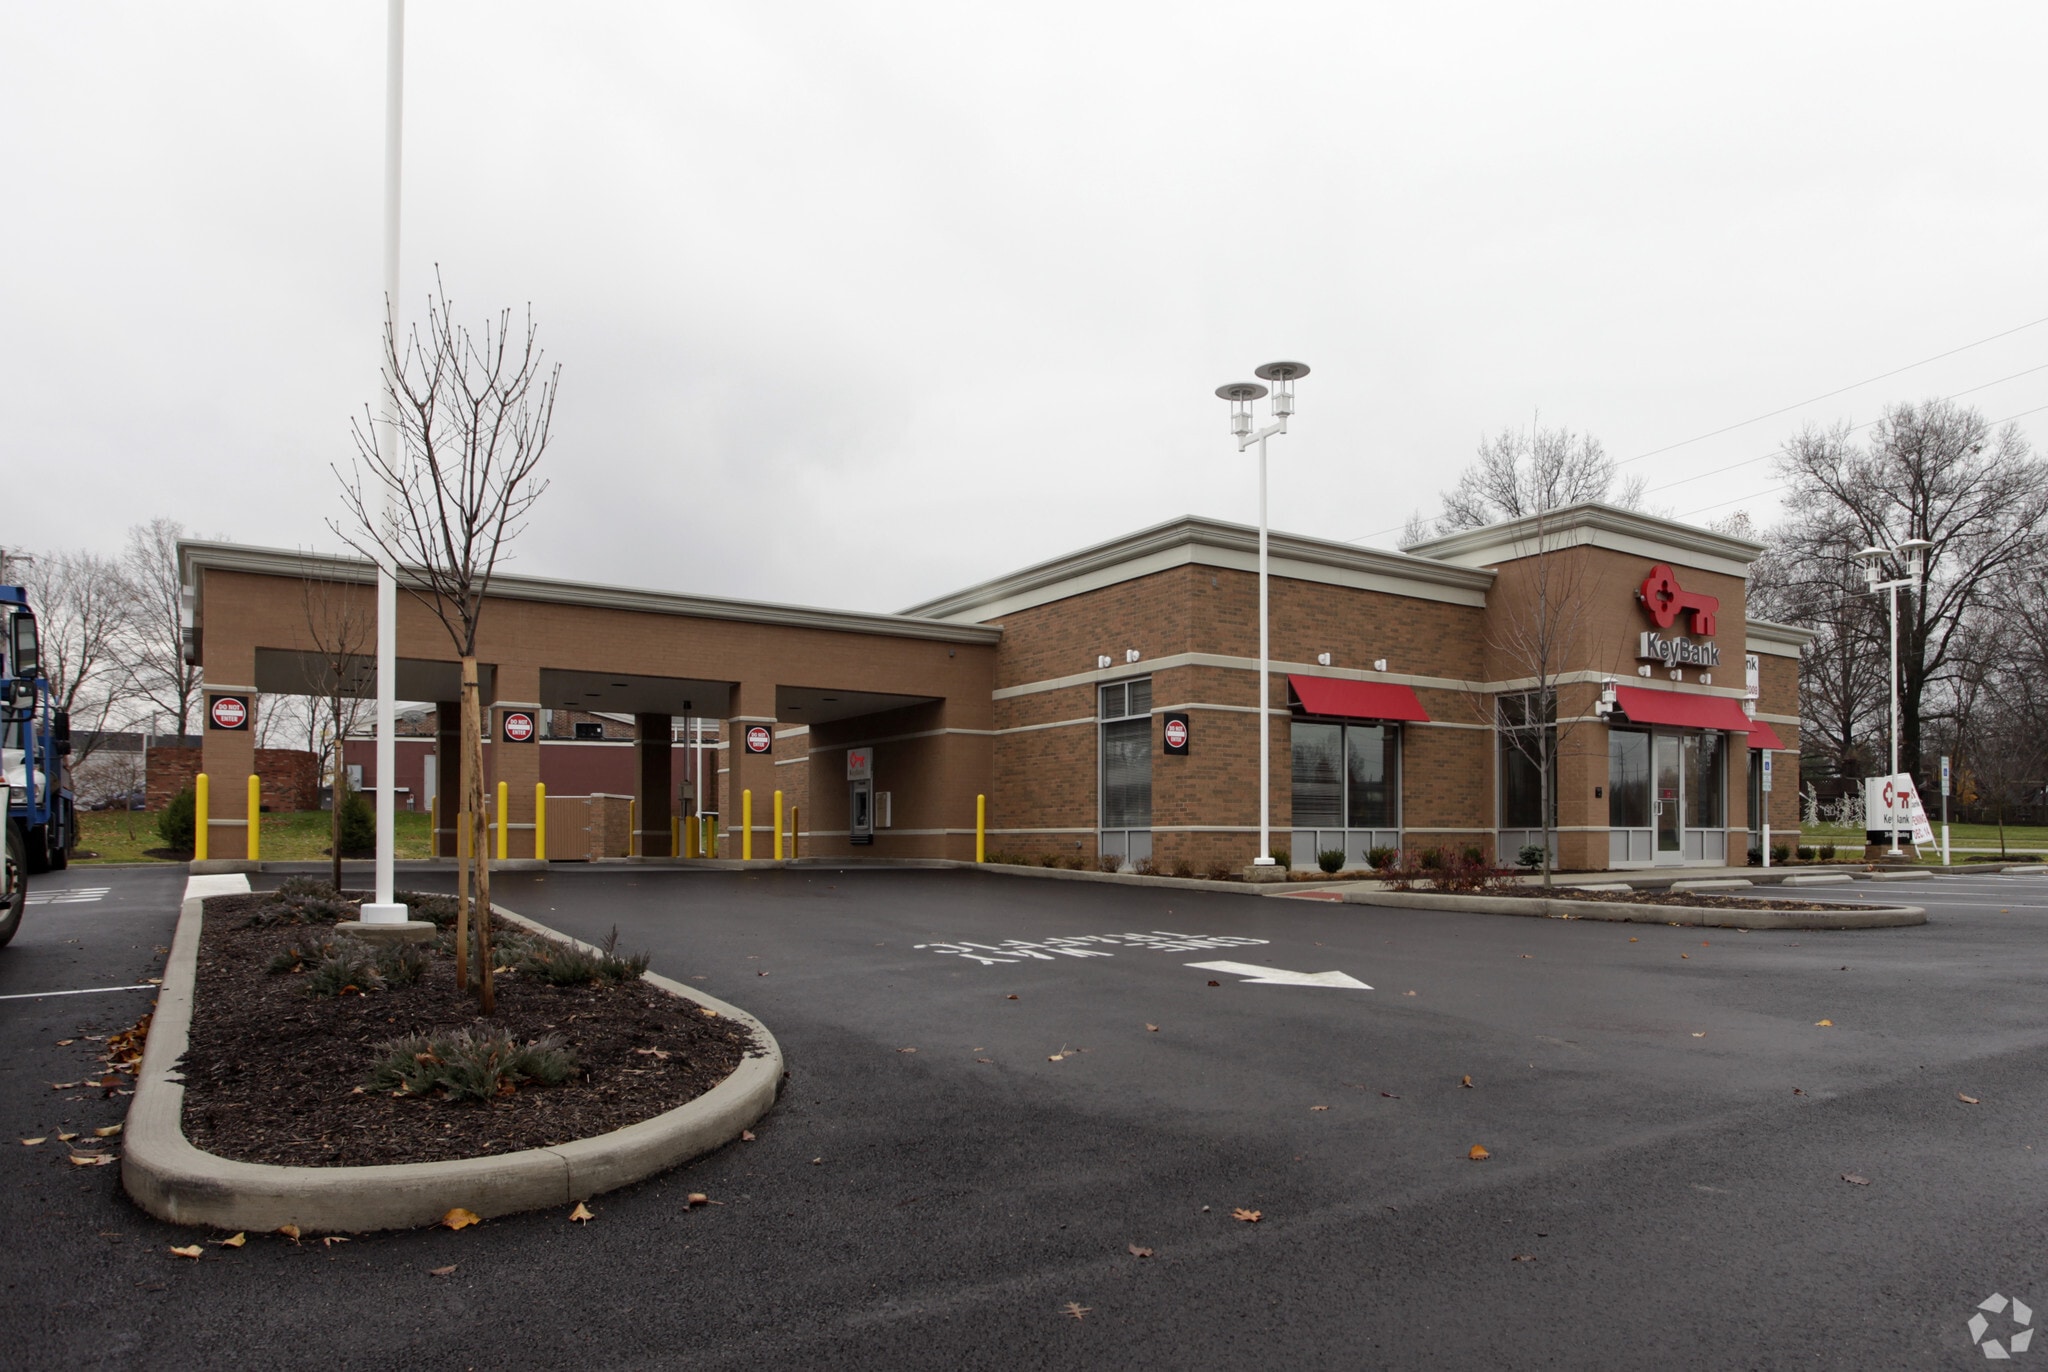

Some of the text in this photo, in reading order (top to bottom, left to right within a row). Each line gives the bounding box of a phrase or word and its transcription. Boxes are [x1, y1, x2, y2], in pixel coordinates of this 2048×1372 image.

[1641, 632, 1720, 667] KeyBank
[1884, 814, 1909, 824] Keank
[914, 931, 1208, 953] TRAFFIC
[959, 936, 1270, 965] ONE WAY
